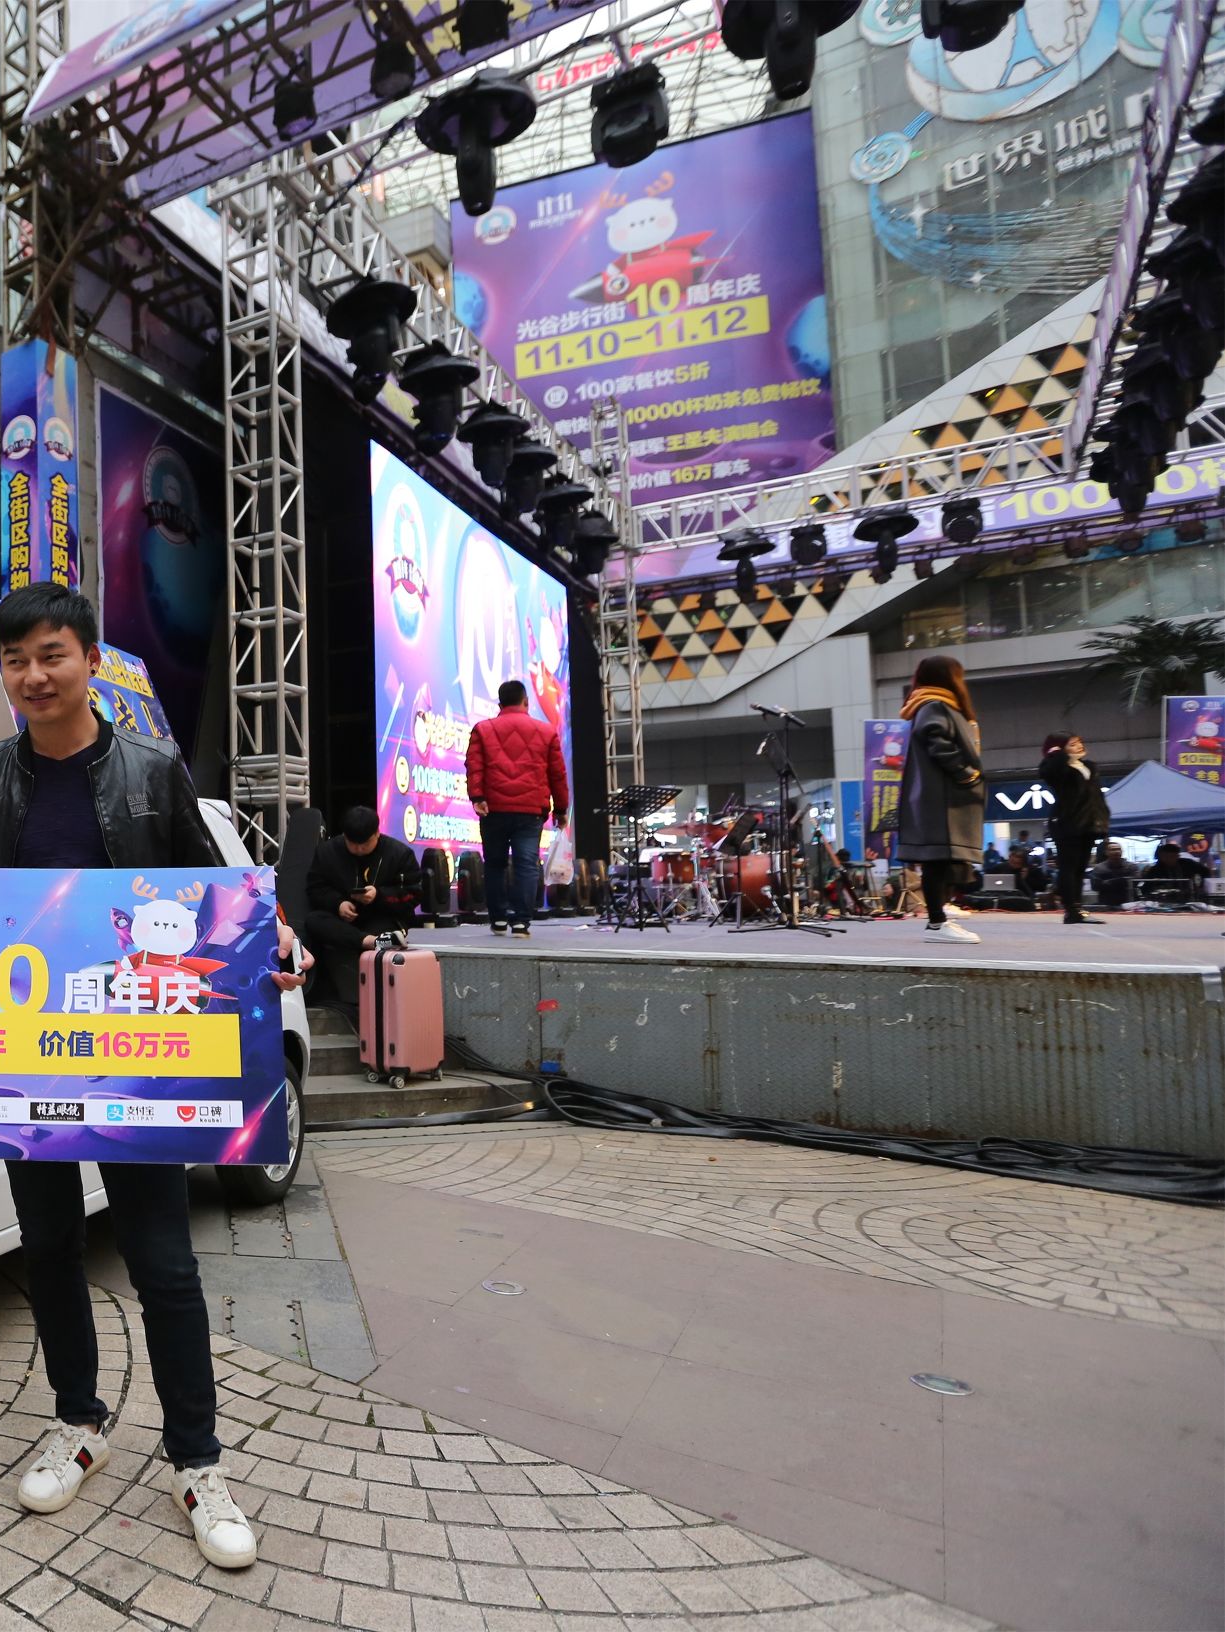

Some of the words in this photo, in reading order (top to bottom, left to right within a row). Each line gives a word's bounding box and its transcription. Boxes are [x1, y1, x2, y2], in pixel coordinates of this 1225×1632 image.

[38, 1029, 191, 1060] 价值16万元
[126, 1105, 155, 1116] 支付宝
[200, 1106, 222, 1117] 口碑
